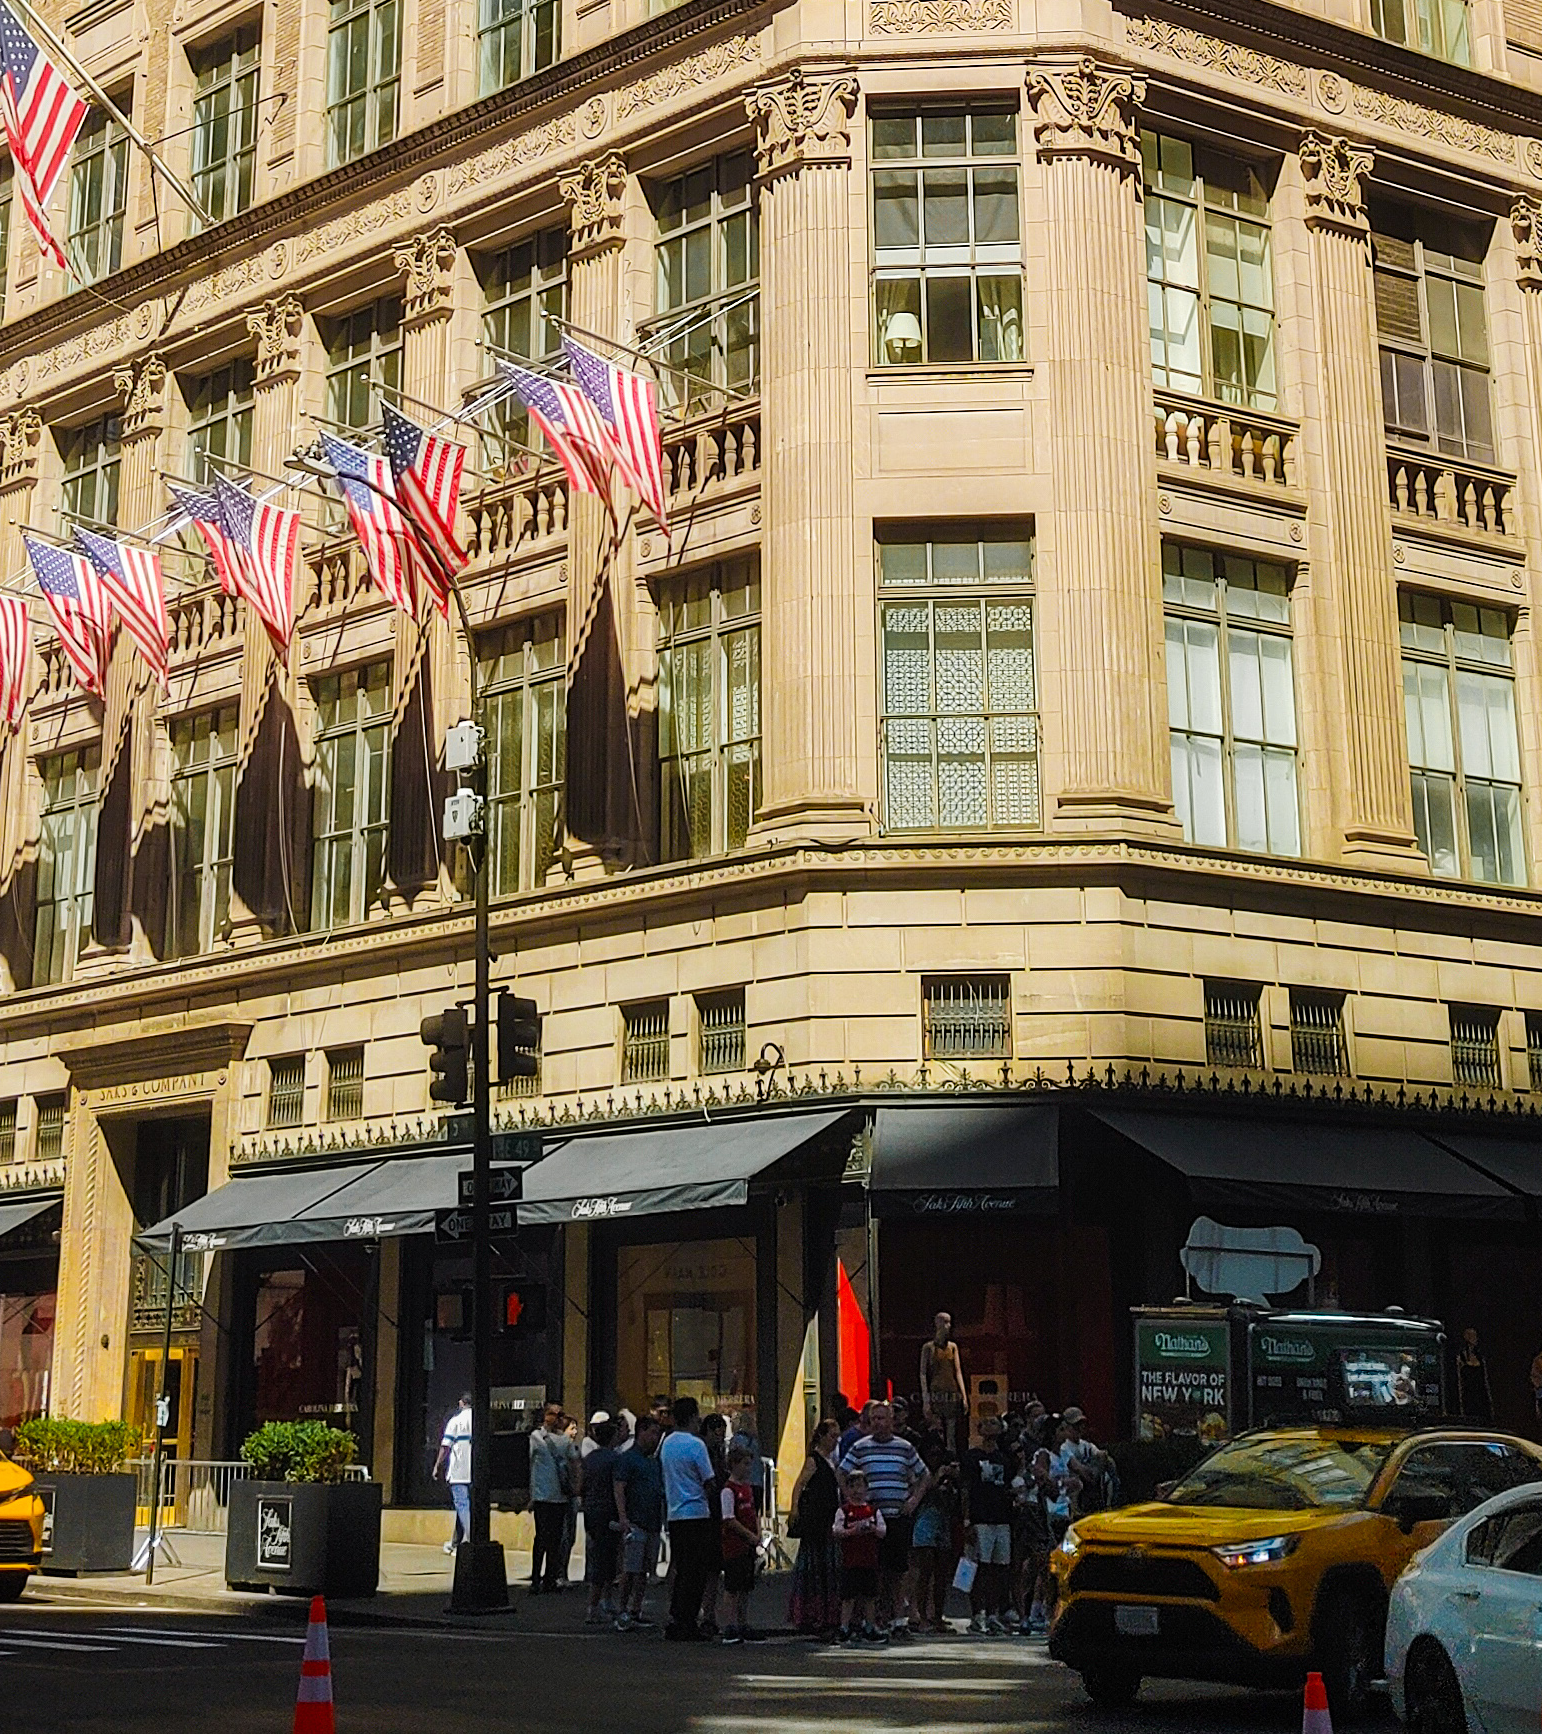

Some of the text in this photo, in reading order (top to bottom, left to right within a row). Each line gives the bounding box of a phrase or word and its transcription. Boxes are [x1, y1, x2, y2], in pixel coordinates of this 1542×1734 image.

[1141, 1370, 1226, 1386] THE FLAVOR OF
[1141, 1385, 1178, 1403] NEW
